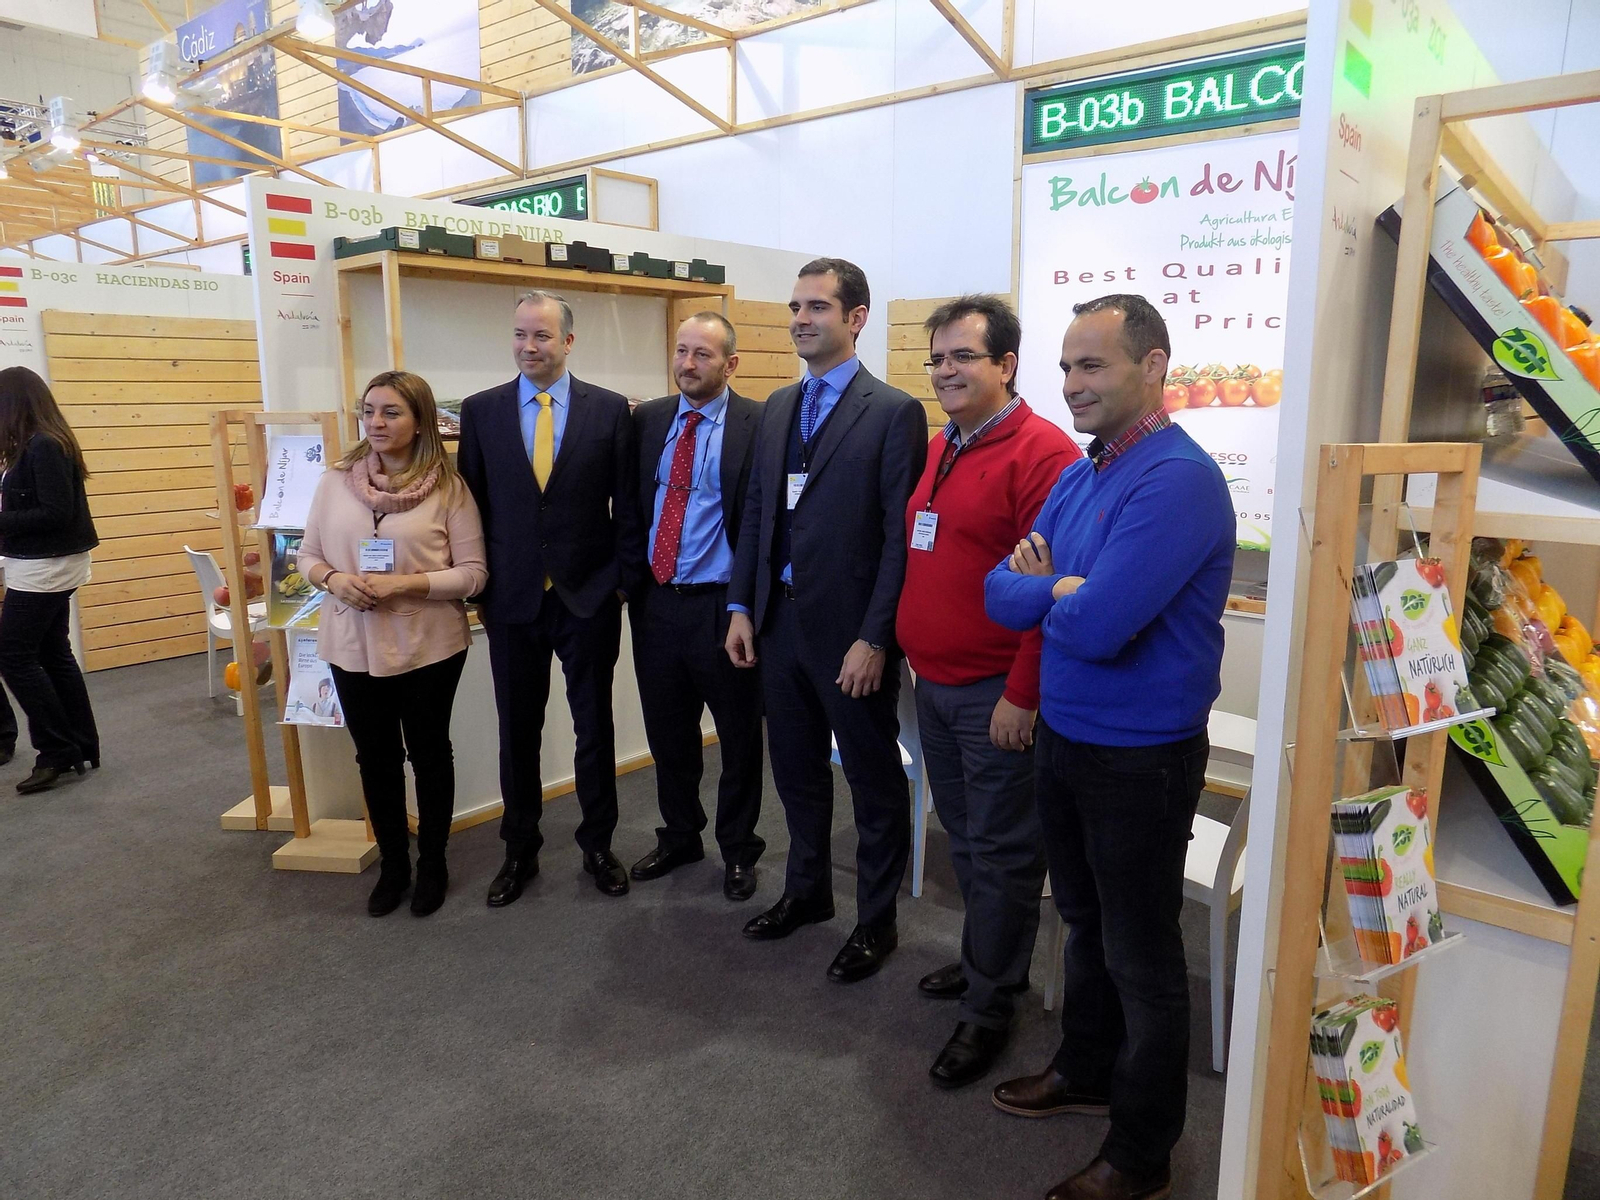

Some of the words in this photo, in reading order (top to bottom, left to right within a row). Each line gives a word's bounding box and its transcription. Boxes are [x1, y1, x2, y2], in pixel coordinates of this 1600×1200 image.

[181, 24, 216, 62] Cádiz
[1040, 92, 1145, 138] B-03b
[1338, 112, 1362, 151] Spain
[1190, 163, 1243, 196] de
[1254, 150, 1298, 201] Ní
[324, 202, 383, 226] B-03b
[1200, 210, 1277, 230] Agricultura
[1282, 207, 1294, 221] E
[1180, 232, 1225, 251] Produkt
[1227, 238, 1246, 247] aus
[1250, 226, 1292, 250] ökologis
[31, 268, 78, 284] B-03c
[96, 273, 190, 290] HACIENDAS
[194, 281, 219, 291] BIO
[273, 270, 311, 284] Spain
[1054, 267, 1136, 285] Best
[1162, 257, 1282, 280] Quali
[1440, 240, 1454, 259] The
[1453, 255, 1482, 294] healthy
[1162, 289, 1201, 304] at
[1195, 313, 1282, 329] Pric
[1209, 452, 1248, 462] ESCO
[1408, 653, 1456, 679] NATÜRLICH
[1397, 883, 1428, 913] NATURAL
[1366, 1095, 1406, 1129] NATURALIDAD
